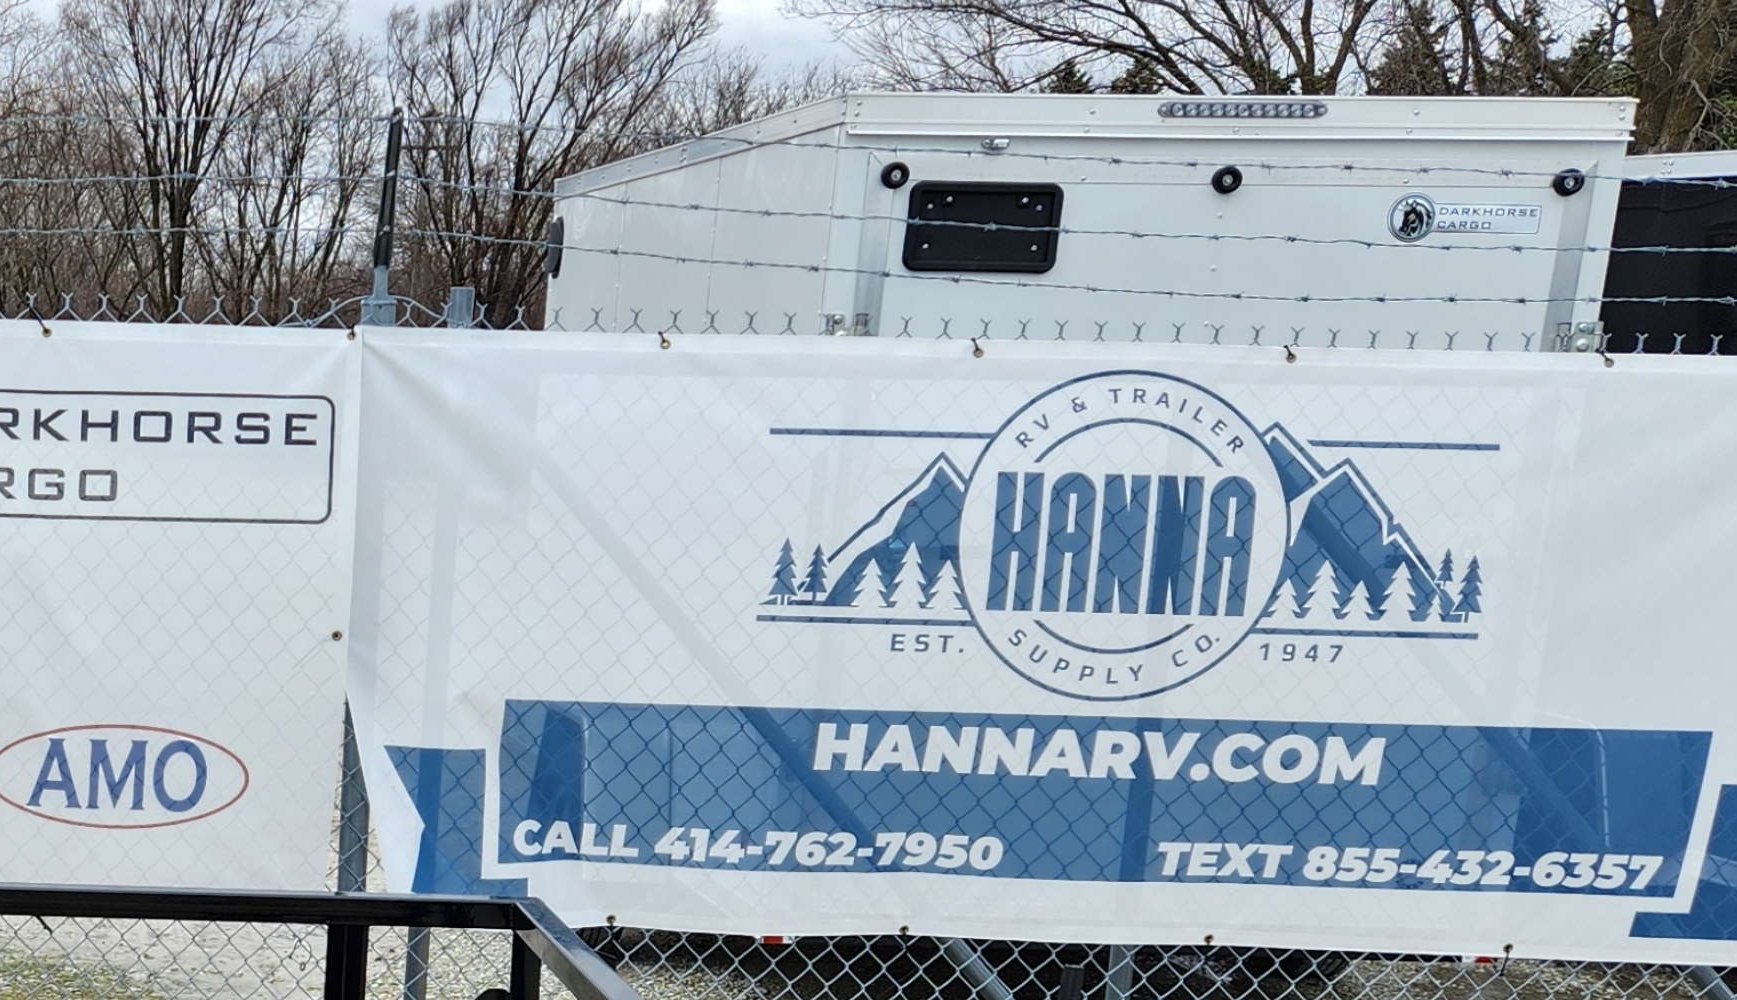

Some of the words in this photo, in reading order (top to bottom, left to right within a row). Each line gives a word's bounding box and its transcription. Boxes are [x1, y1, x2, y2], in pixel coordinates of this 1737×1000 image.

[1437, 221, 1492, 230] CARGO
[1439, 207, 1538, 217] DARKHORSE
[1015, 414, 1051, 449] RV
[1070, 396, 1088, 414] &
[1108, 388, 1245, 454] TRAILER
[985, 471, 1257, 617] HANNA
[889, 632, 966, 654] EST.
[1007, 628, 1144, 685] SUPPLY
[1171, 635, 1222, 669] CO.
[1258, 642, 1345, 664] 1947
[26, 737, 208, 812] AMO
[812, 722, 1387, 786] HANNARV.COM
[512, 819, 640, 859] CALL
[653, 826, 1004, 871] 414-762-7950
[1156, 841, 1294, 879] TEXT
[1302, 846, 1664, 890] 855-432-6357
